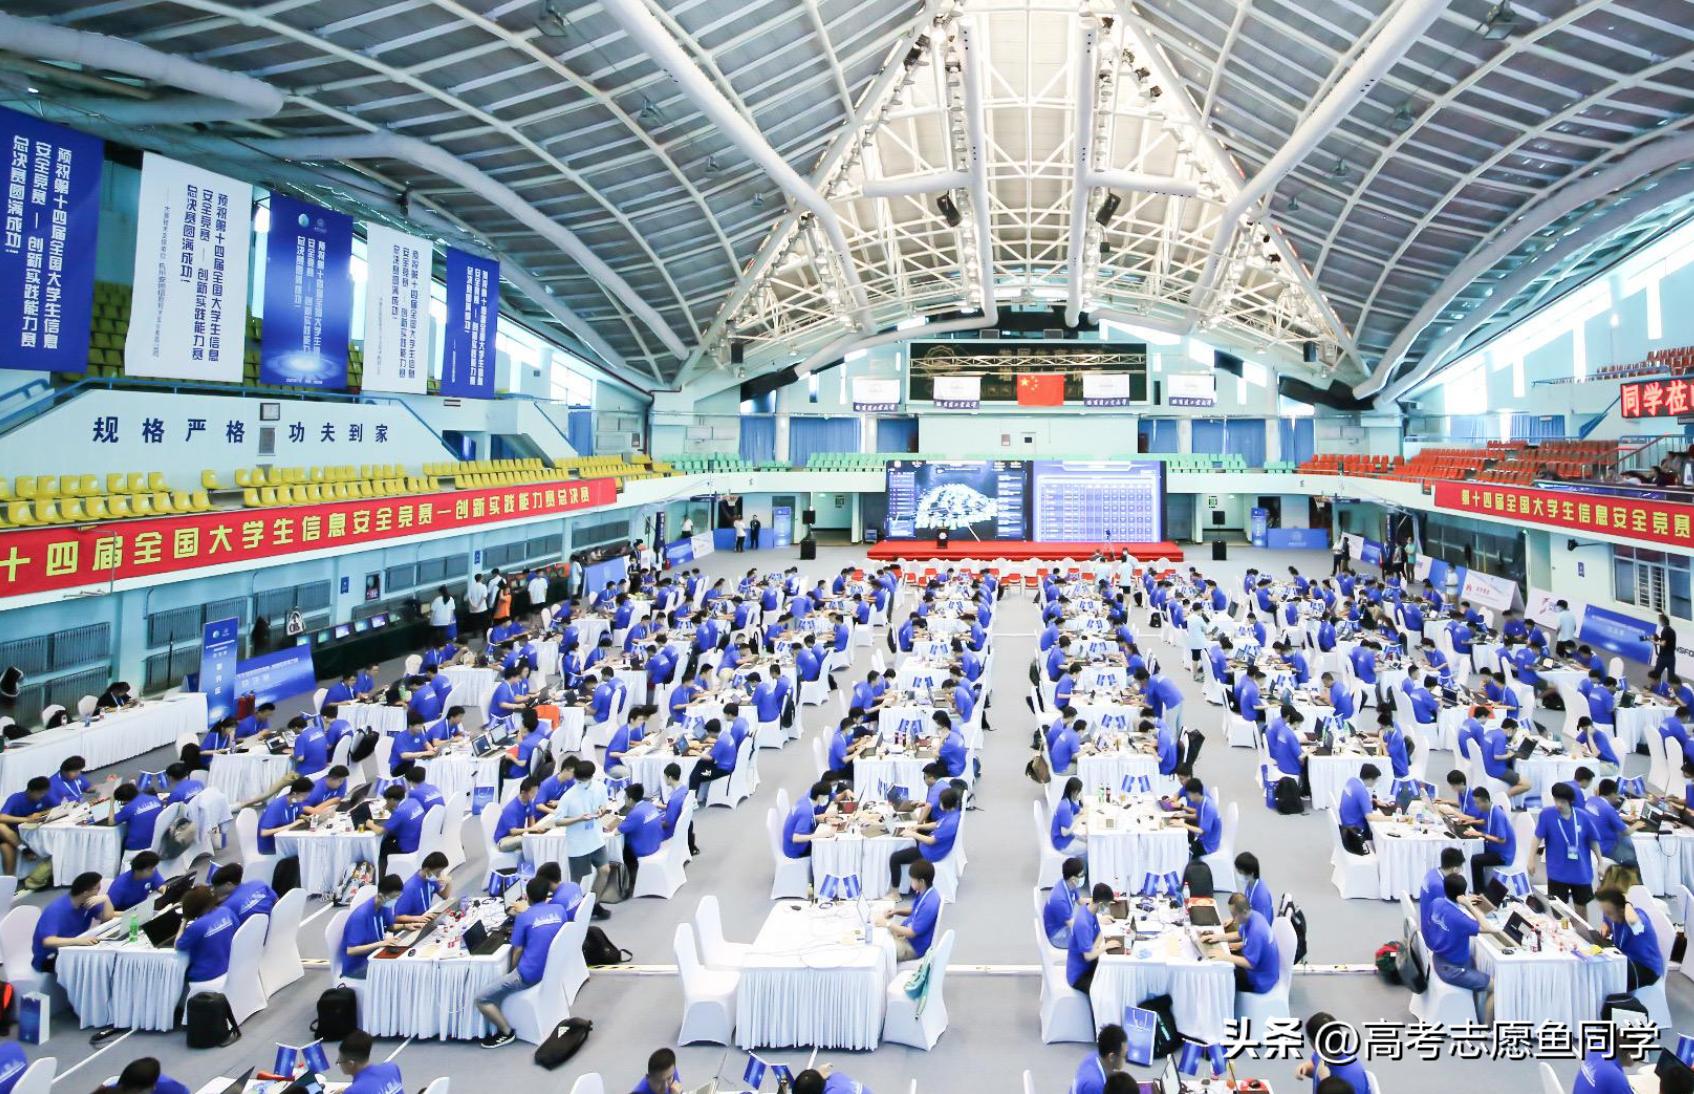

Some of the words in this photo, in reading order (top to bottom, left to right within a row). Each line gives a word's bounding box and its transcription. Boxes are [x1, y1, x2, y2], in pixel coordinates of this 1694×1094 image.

[43, 147, 73, 349] 预祝第十四届全国大学生信息
[1621, 380, 1694, 416] 同学莅
[92, 416, 246, 444] 规格严格
[288, 421, 389, 444] 功夫到家
[1461, 489, 1691, 538] 第十四届全国大学生信息安全竞赛
